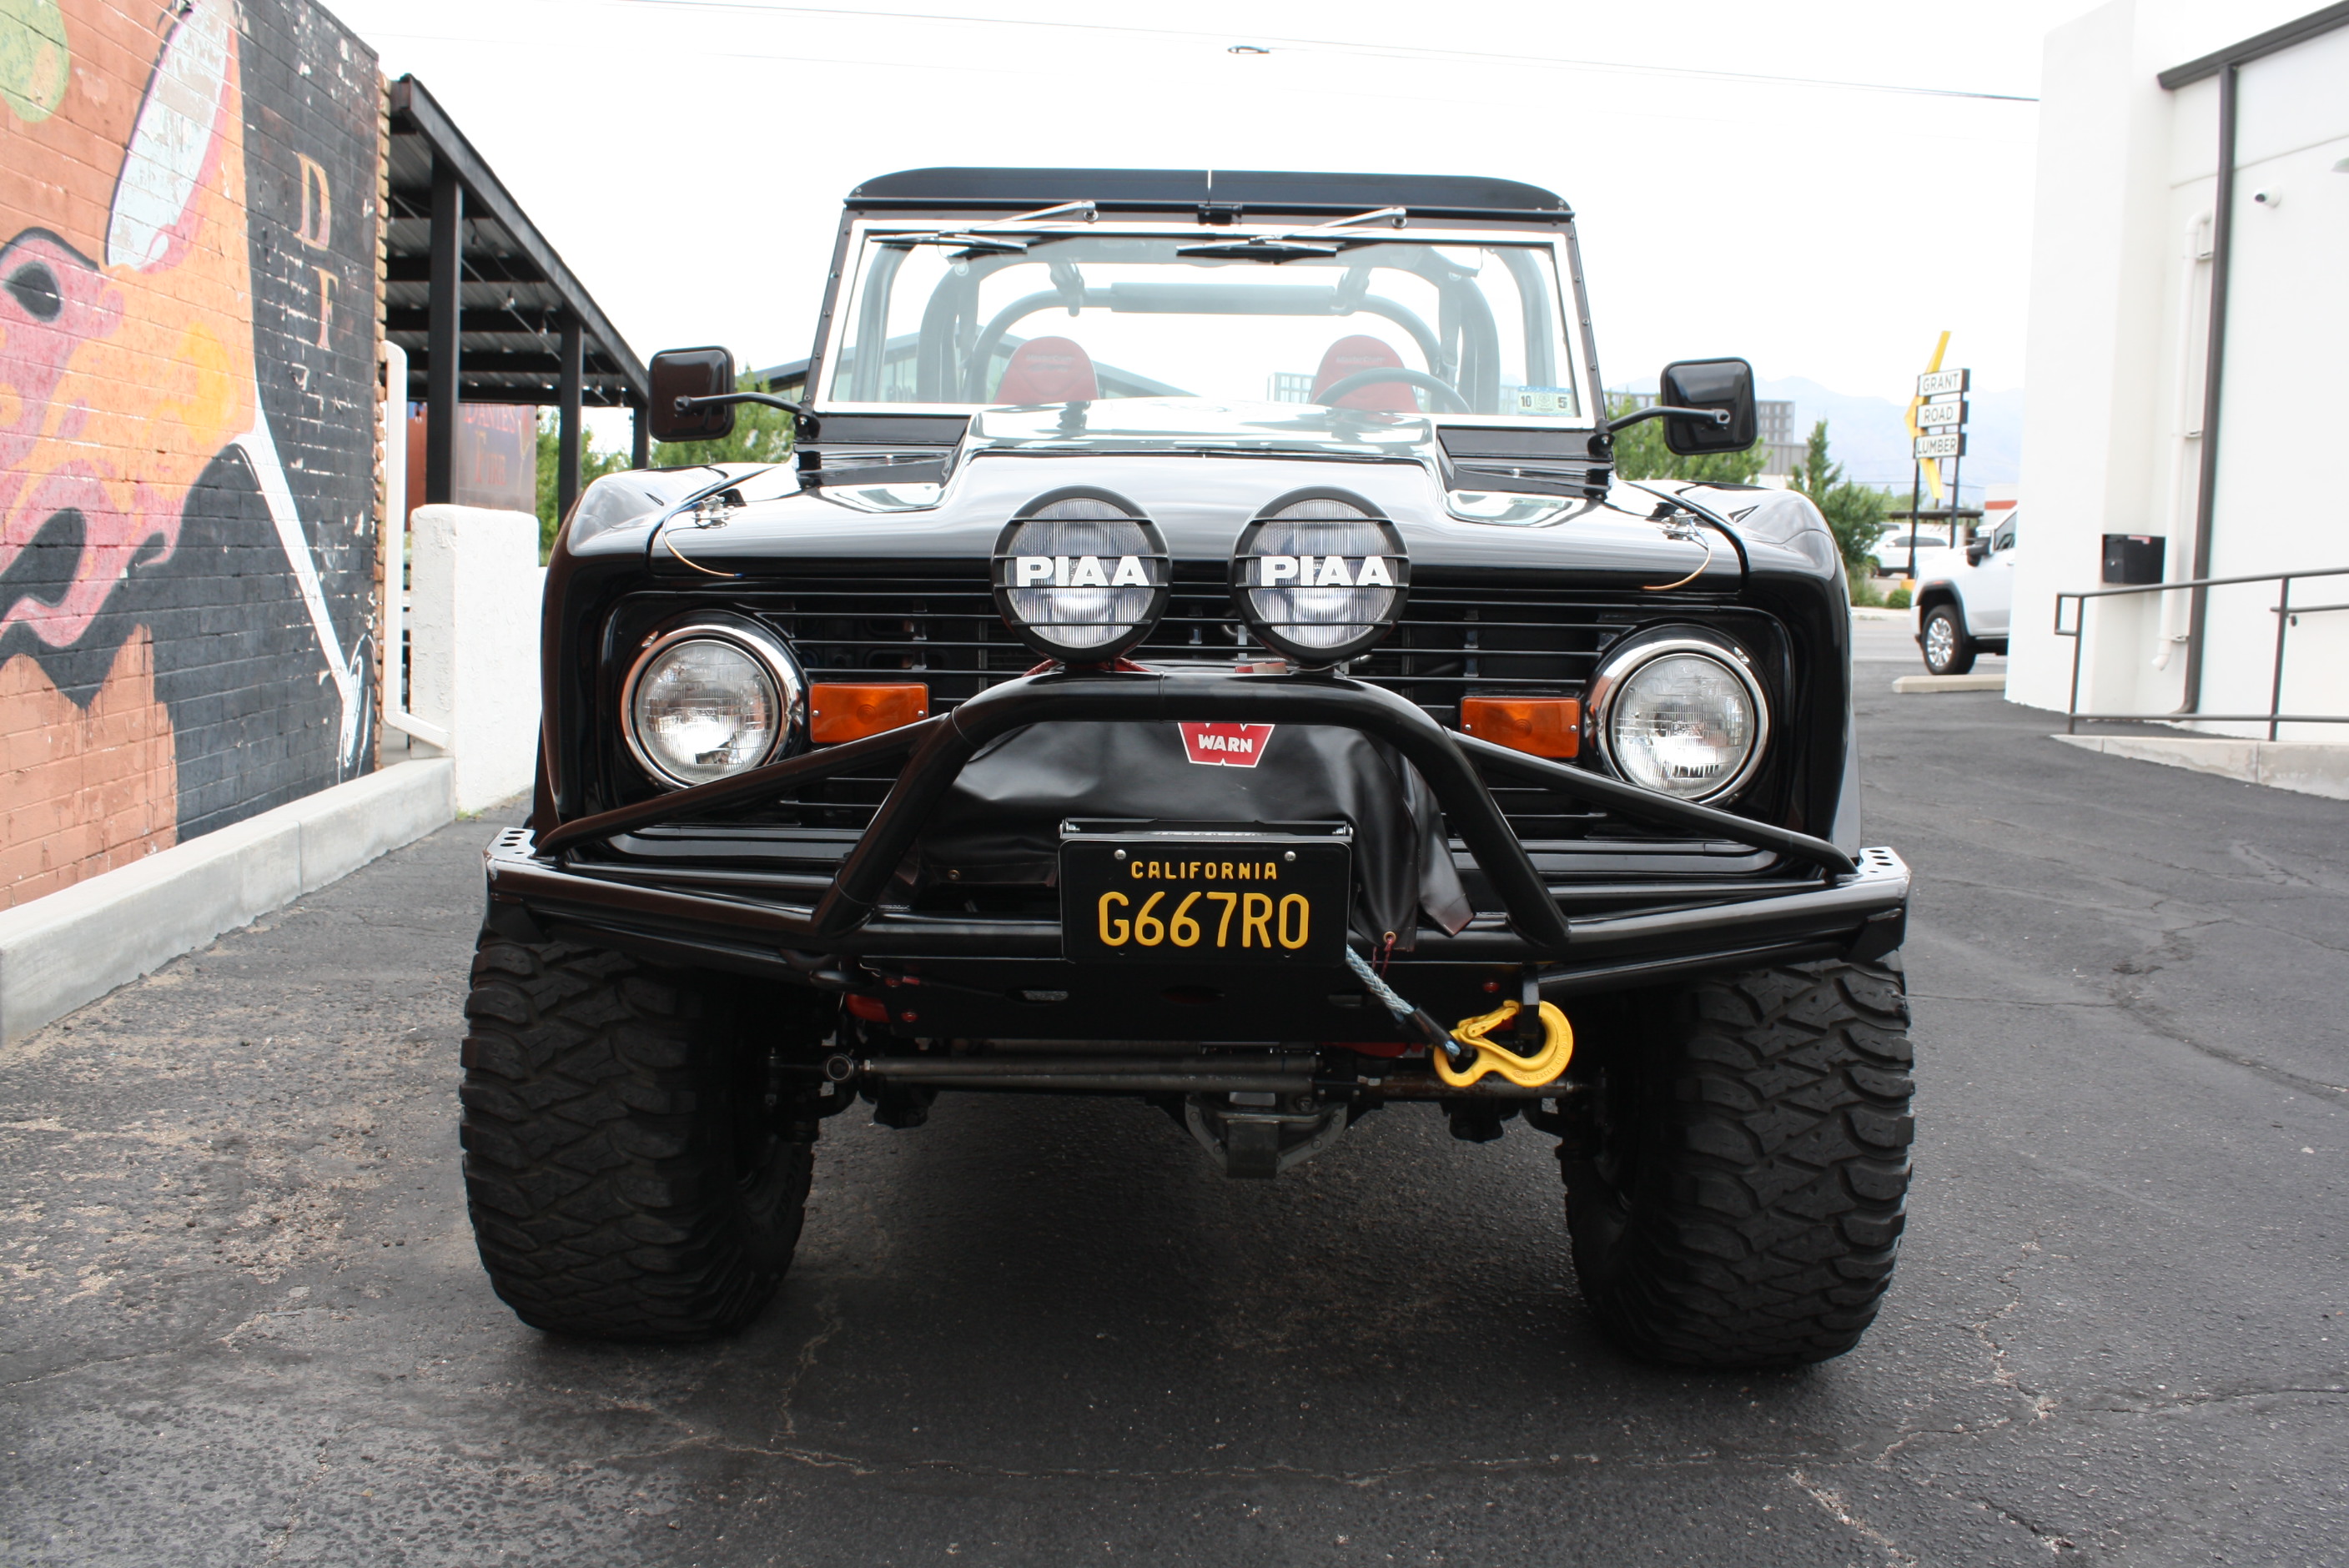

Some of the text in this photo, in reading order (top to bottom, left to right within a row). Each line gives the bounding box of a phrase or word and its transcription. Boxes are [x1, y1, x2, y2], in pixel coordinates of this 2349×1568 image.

[1923, 373, 1959, 392] GRANT
[1521, 395, 1532, 408] 10
[1924, 406, 1954, 423] ROAD
[1917, 438, 1957, 455] LUMBER
[1016, 555, 1149, 587] PIAA
[1260, 555, 1393, 587] PIAA
[1198, 734, 1252, 753] WARN
[1131, 861, 1277, 880] CALIFORNIA
